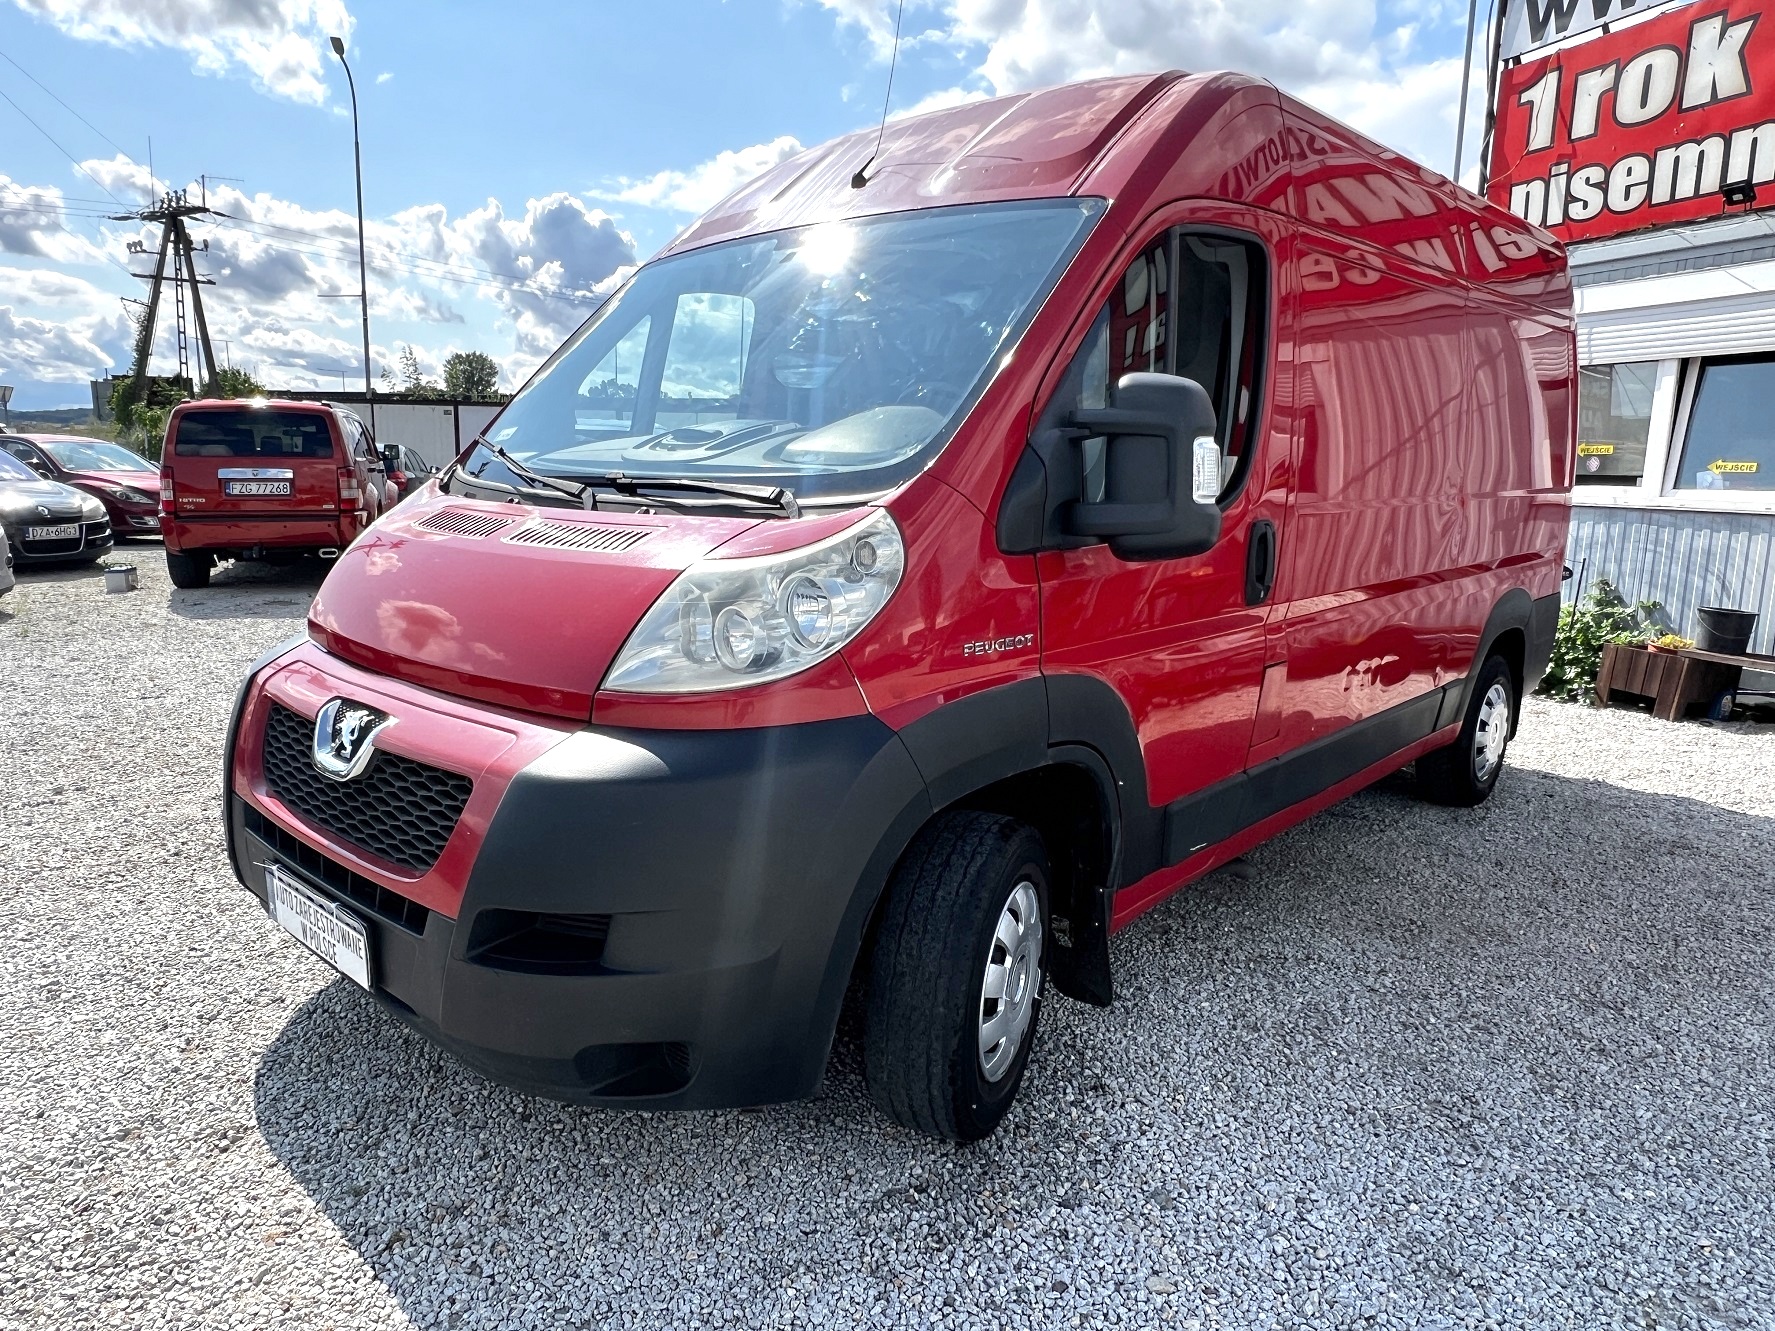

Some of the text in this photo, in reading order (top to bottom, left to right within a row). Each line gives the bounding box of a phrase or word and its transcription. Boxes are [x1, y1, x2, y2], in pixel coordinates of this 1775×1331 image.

[1518, 10, 1762, 154] 1 rok
[1715, 463, 1755, 472] WEJŚCIE
[231, 483, 289, 494] FZG 77268
[964, 633, 1034, 657] PEUGEOT
[309, 926, 338, 965] POLSCE
